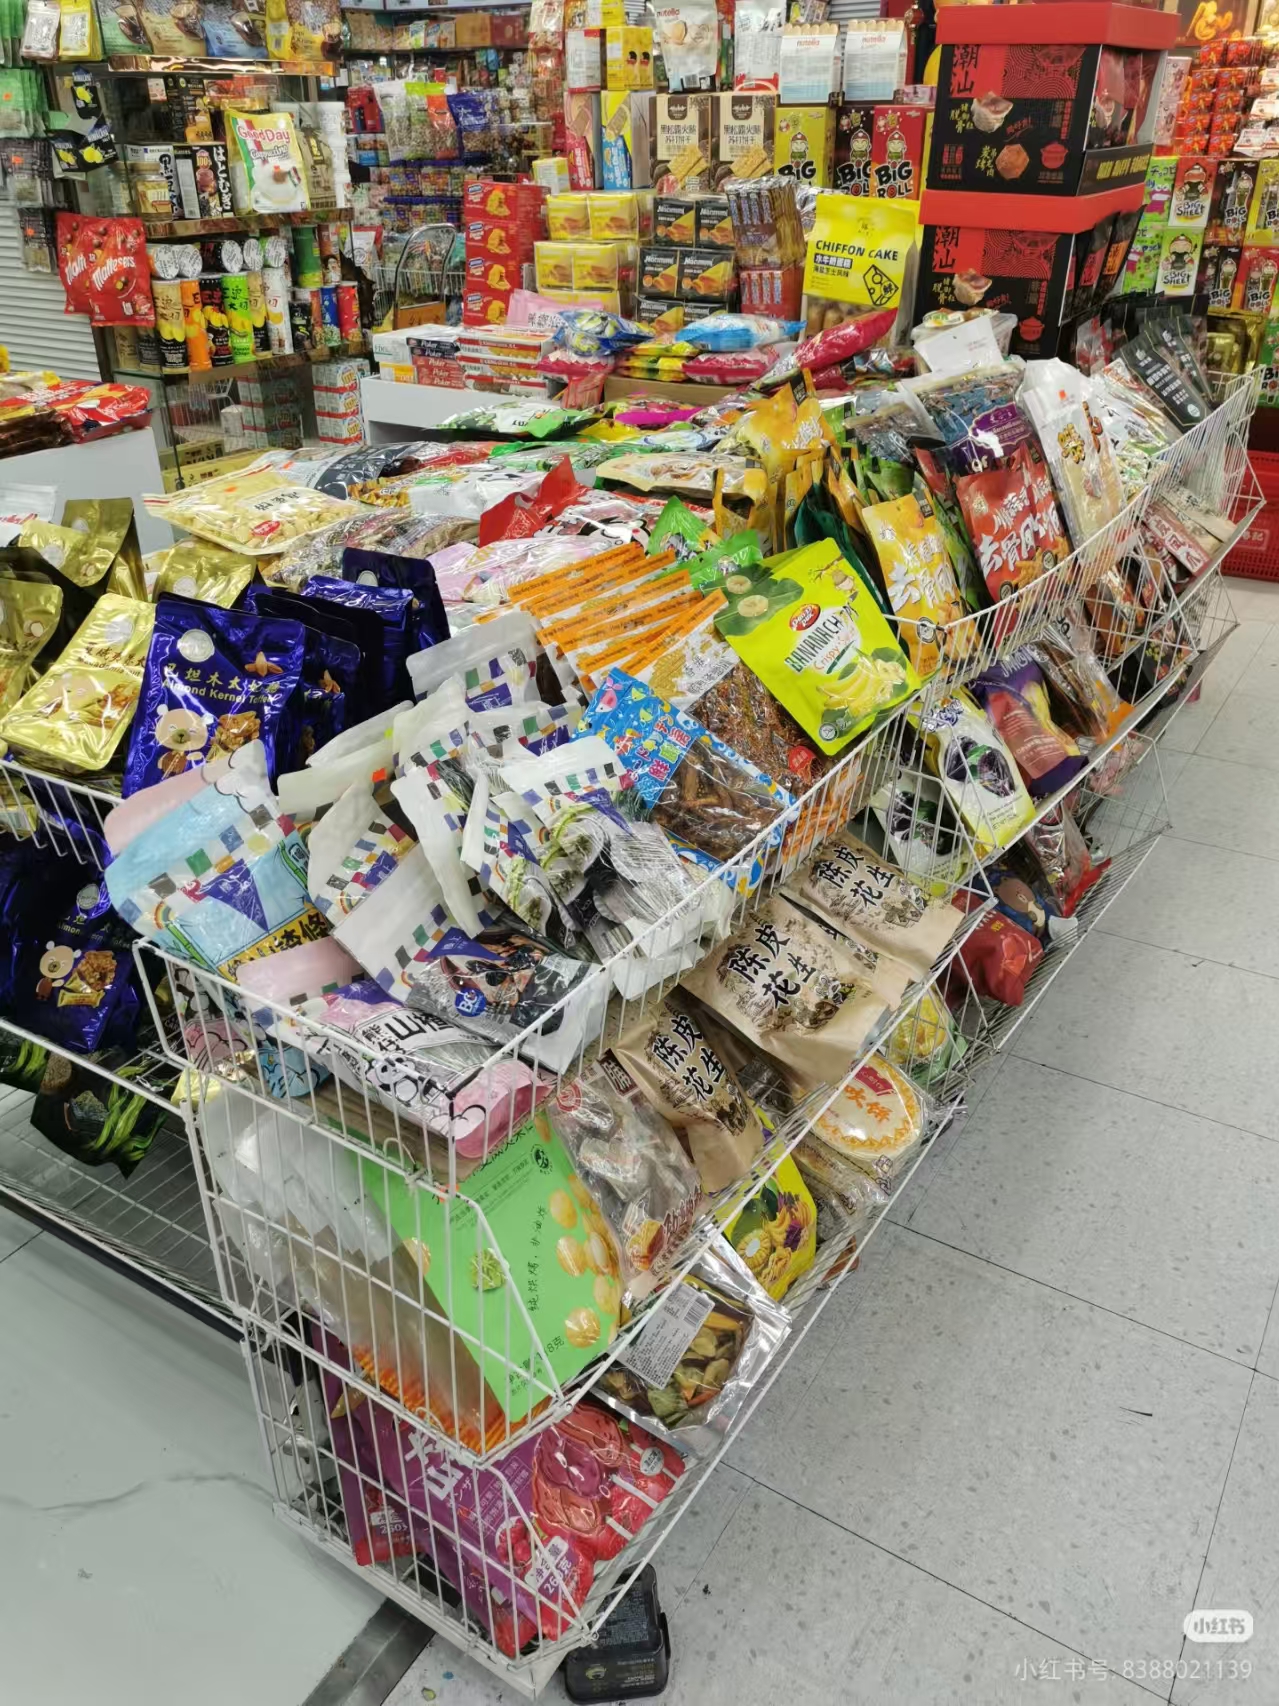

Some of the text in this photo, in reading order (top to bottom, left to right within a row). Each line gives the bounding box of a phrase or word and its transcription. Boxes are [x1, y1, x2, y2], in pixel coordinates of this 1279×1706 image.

[874, 160, 913, 187] BiG
[877, 181, 913, 199] ROLL
[1225, 207, 1247, 218] BiG
[815, 239, 899, 261] CHIFFON CAKE
[92, 255, 136, 292] Maltesers
[813, 645, 841, 671] Crispy
[161, 678, 206, 697] Almond
[209, 688, 246, 704] Kernel
[727, 923, 791, 984] 陈皮
[761, 952, 817, 1009] 花生
[652, 1014, 704, 1073] 陈皮
[682, 1046, 726, 1101] 花生
